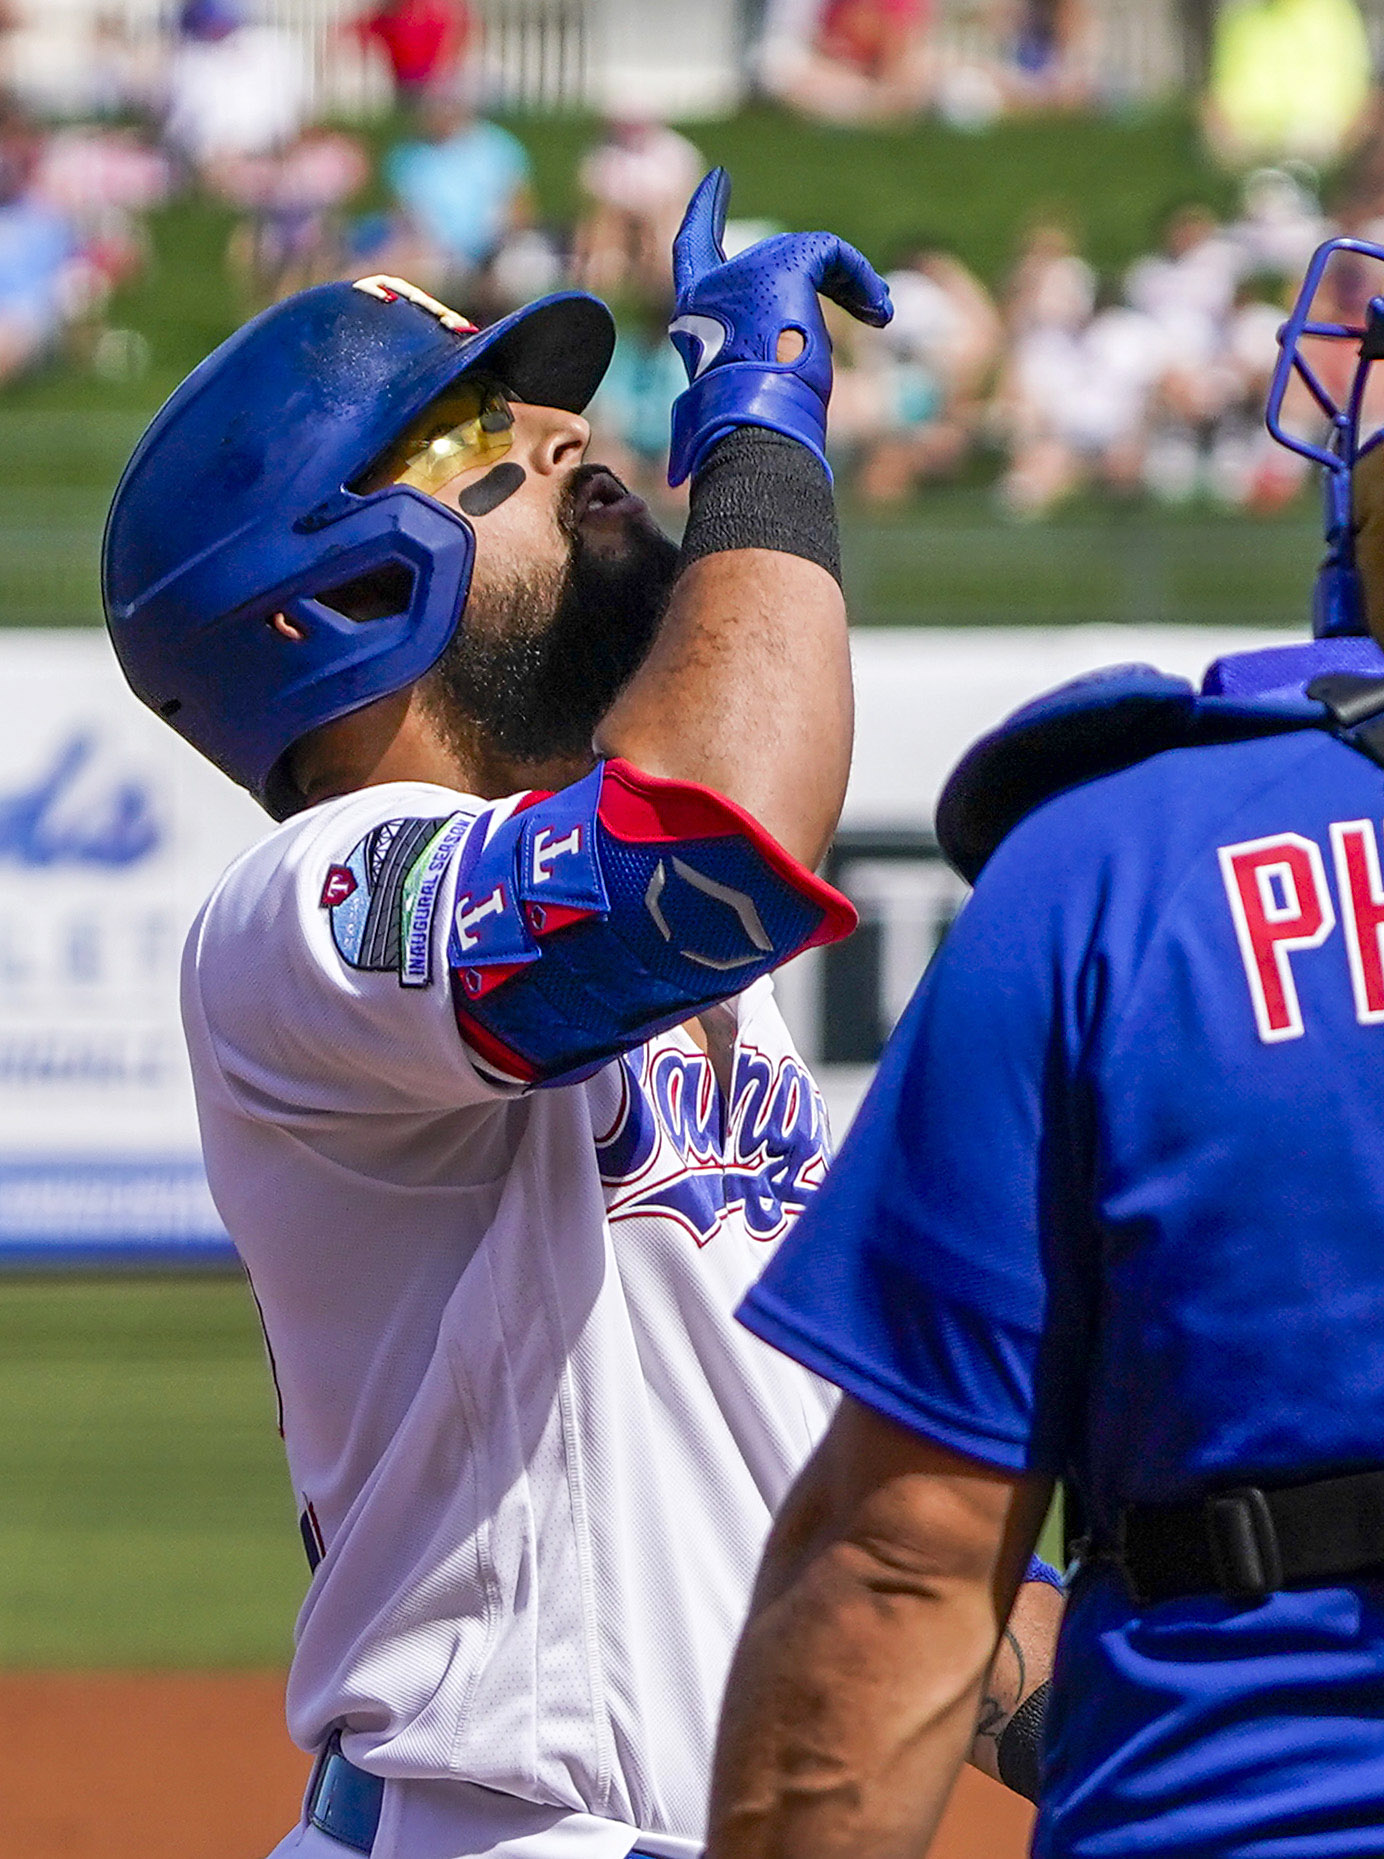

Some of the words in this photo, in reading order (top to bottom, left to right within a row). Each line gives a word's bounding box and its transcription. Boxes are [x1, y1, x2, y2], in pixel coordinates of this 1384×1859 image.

[533, 824, 584, 885] T
[408, 875, 438, 976] INAUGURAL
[428, 817, 473, 873] SEASON
[454, 882, 507, 952] T
